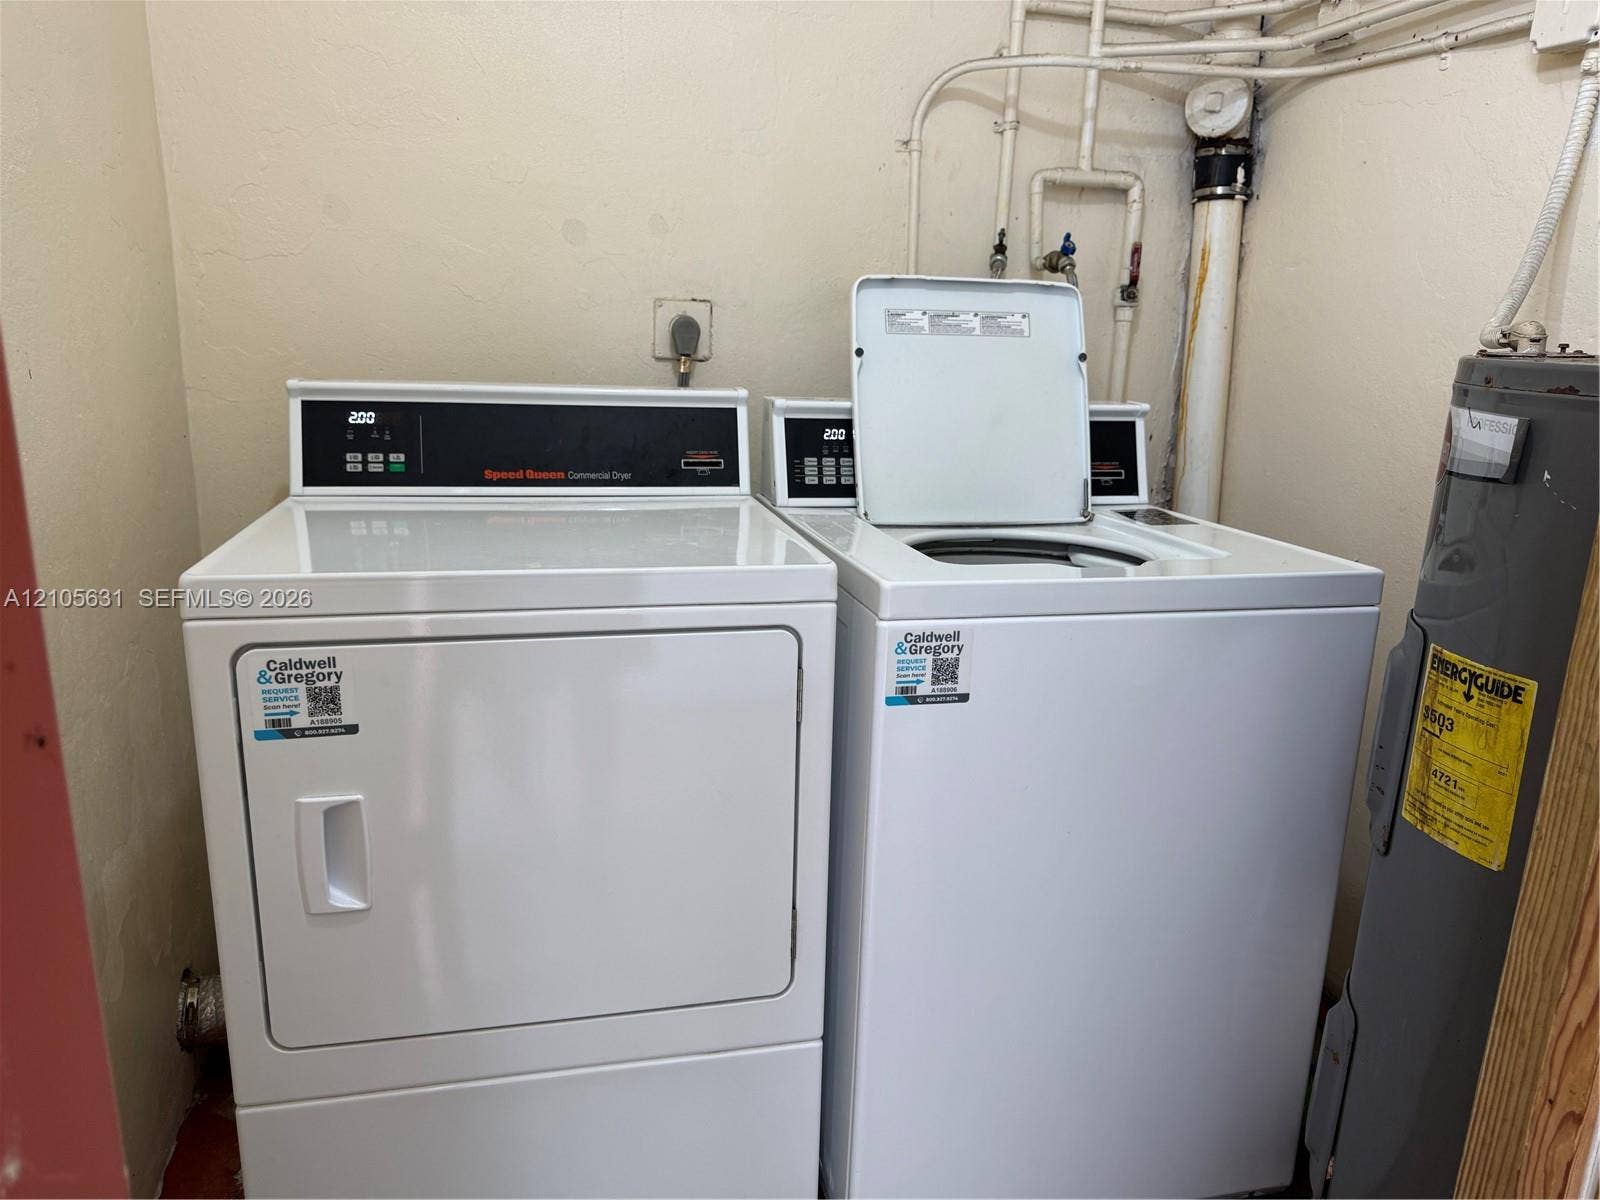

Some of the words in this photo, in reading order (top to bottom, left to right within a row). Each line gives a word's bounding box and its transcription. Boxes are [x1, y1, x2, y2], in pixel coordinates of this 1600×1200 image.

[348, 411, 376, 424] 2.00
[823, 428, 846, 440] 2.00
[484, 469, 524, 481] Speed
[525, 469, 565, 480] Queen
[567, 470, 611, 480] Commercial
[612, 470, 632, 482] Dryer
[904, 630, 960, 644] Caldwell
[908, 643, 964, 657] Gregory
[266, 656, 337, 672] Caldwell
[274, 670, 343, 686] Gregory
[262, 687, 299, 696] REQUEST
[262, 695, 300, 703] SERVICE
[309, 717, 343, 726] A188905
[1423, 705, 1455, 732] $503
[1431, 768, 1458, 790] 4721
